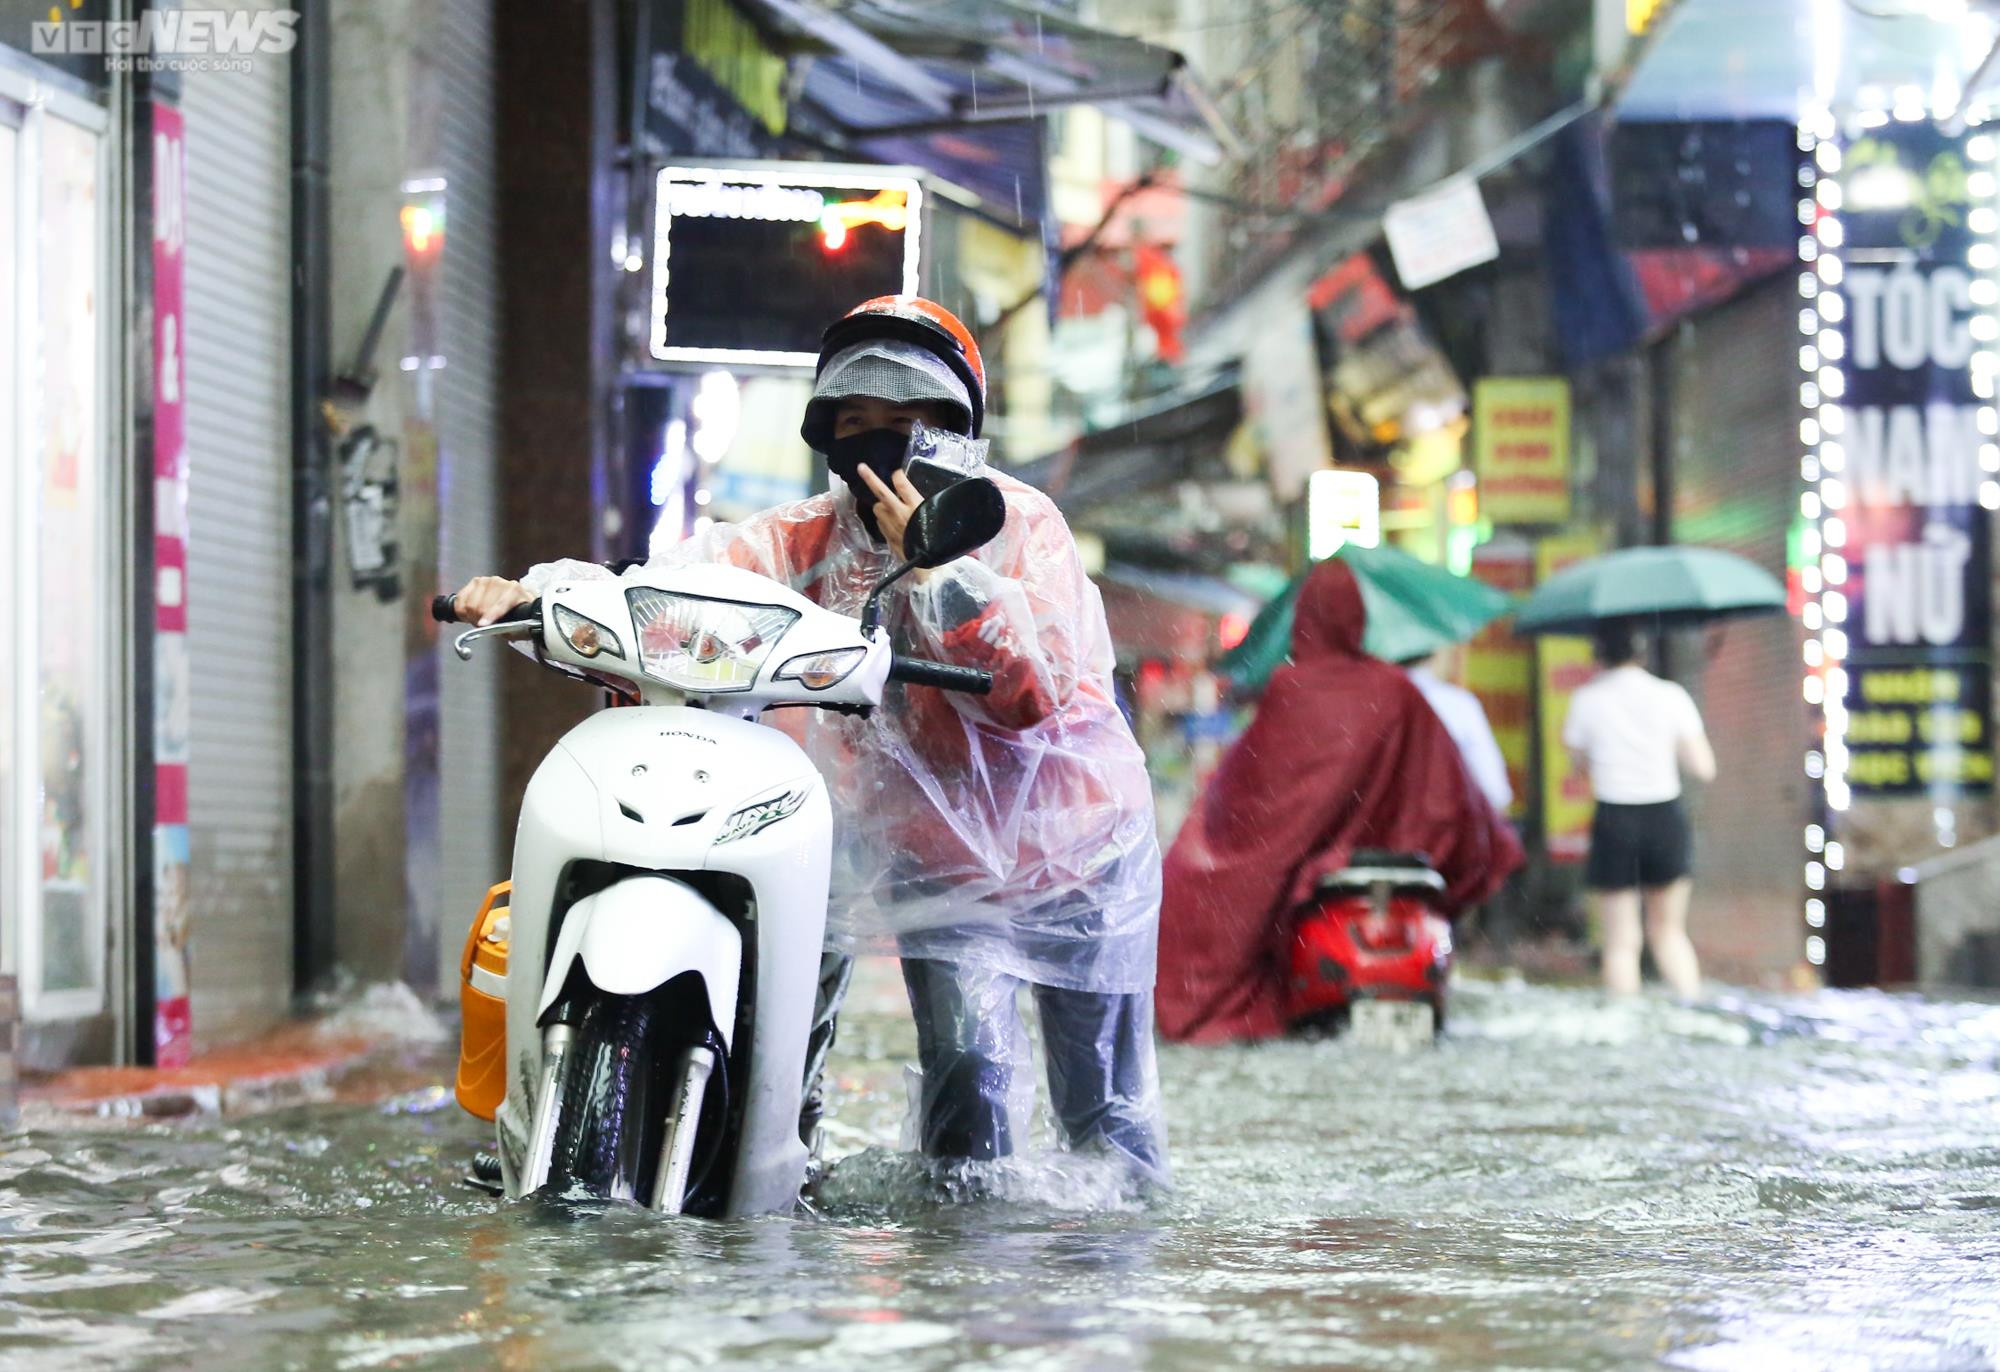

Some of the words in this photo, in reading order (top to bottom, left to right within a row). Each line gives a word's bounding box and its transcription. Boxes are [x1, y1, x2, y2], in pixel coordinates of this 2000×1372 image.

[1846, 259, 1974, 370] TÓC
[1842, 404, 1980, 506] NAM
[1864, 522, 1972, 646] NỮ
[659, 730, 717, 745] HONDA
